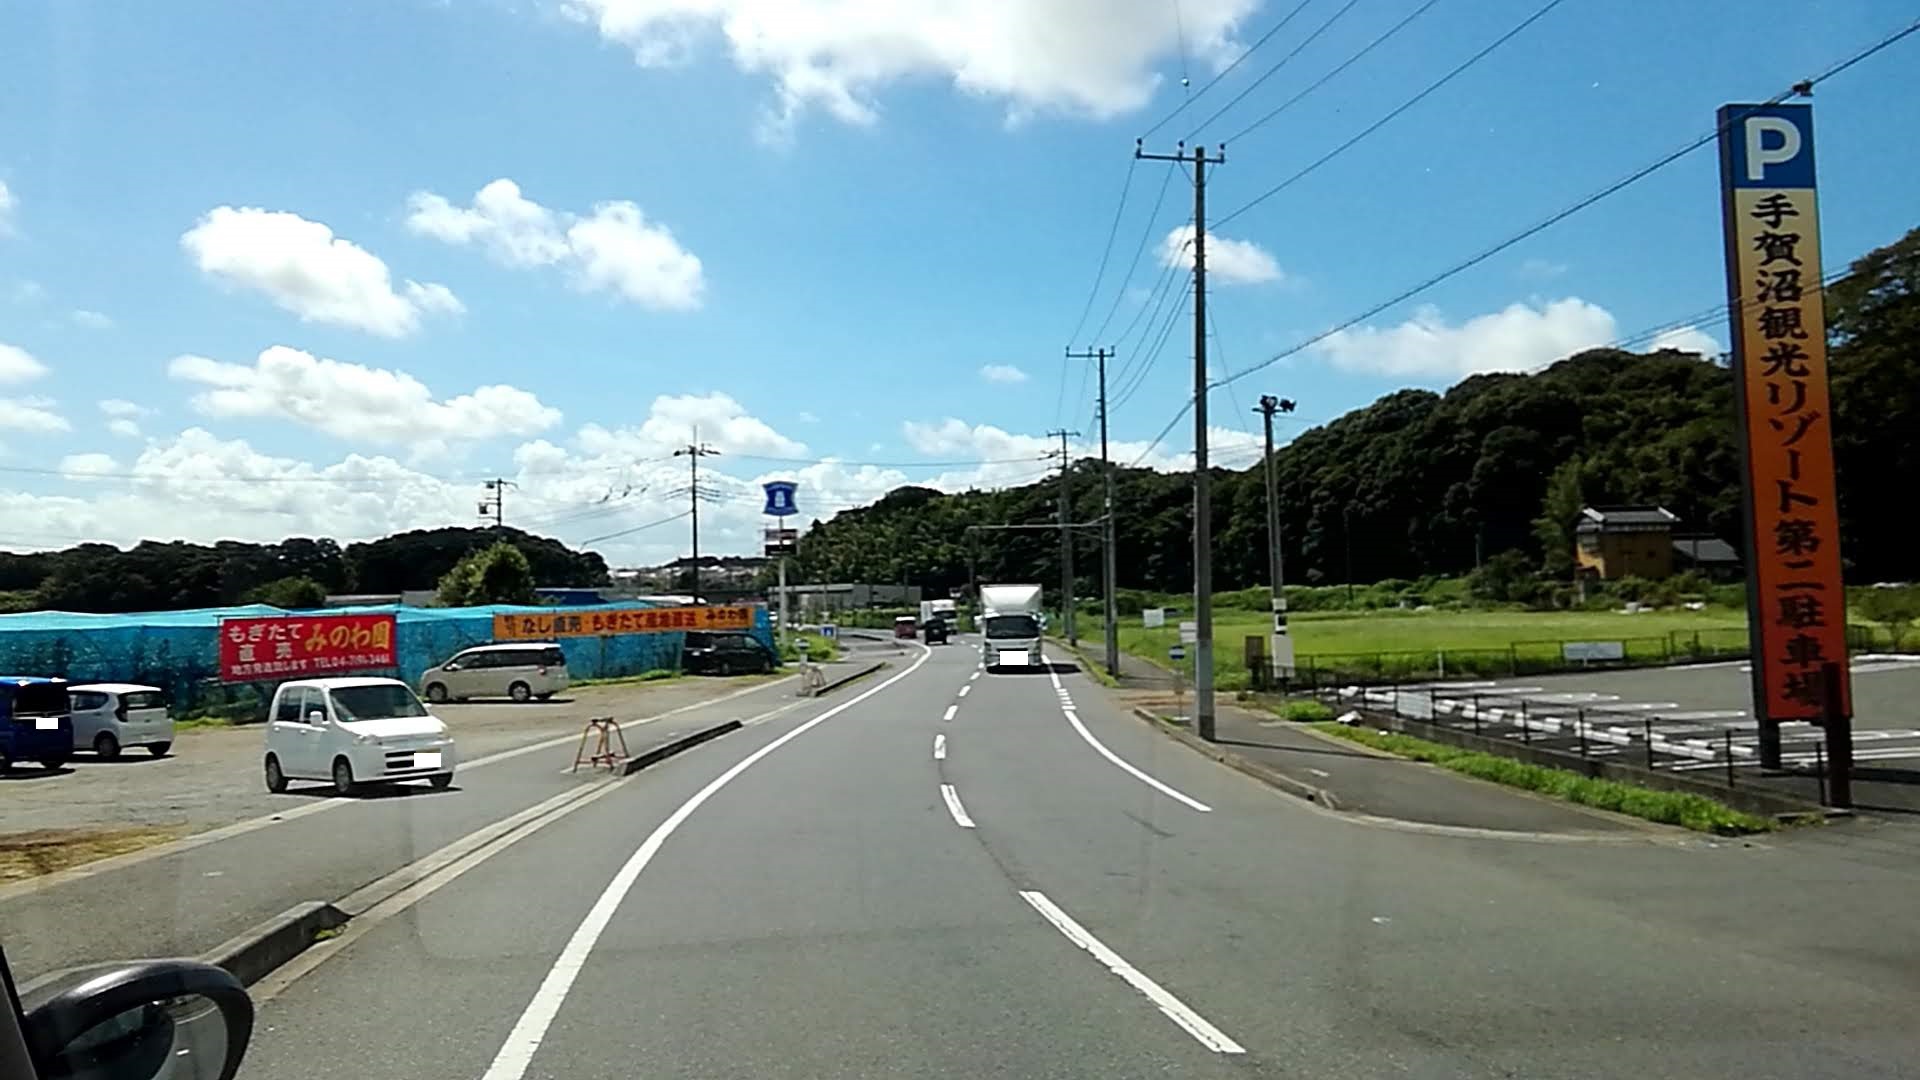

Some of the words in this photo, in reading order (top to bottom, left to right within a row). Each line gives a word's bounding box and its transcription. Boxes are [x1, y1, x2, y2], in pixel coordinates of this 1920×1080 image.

[1744, 116, 1801, 181] P
[228, 622, 303, 643] もぎたて
